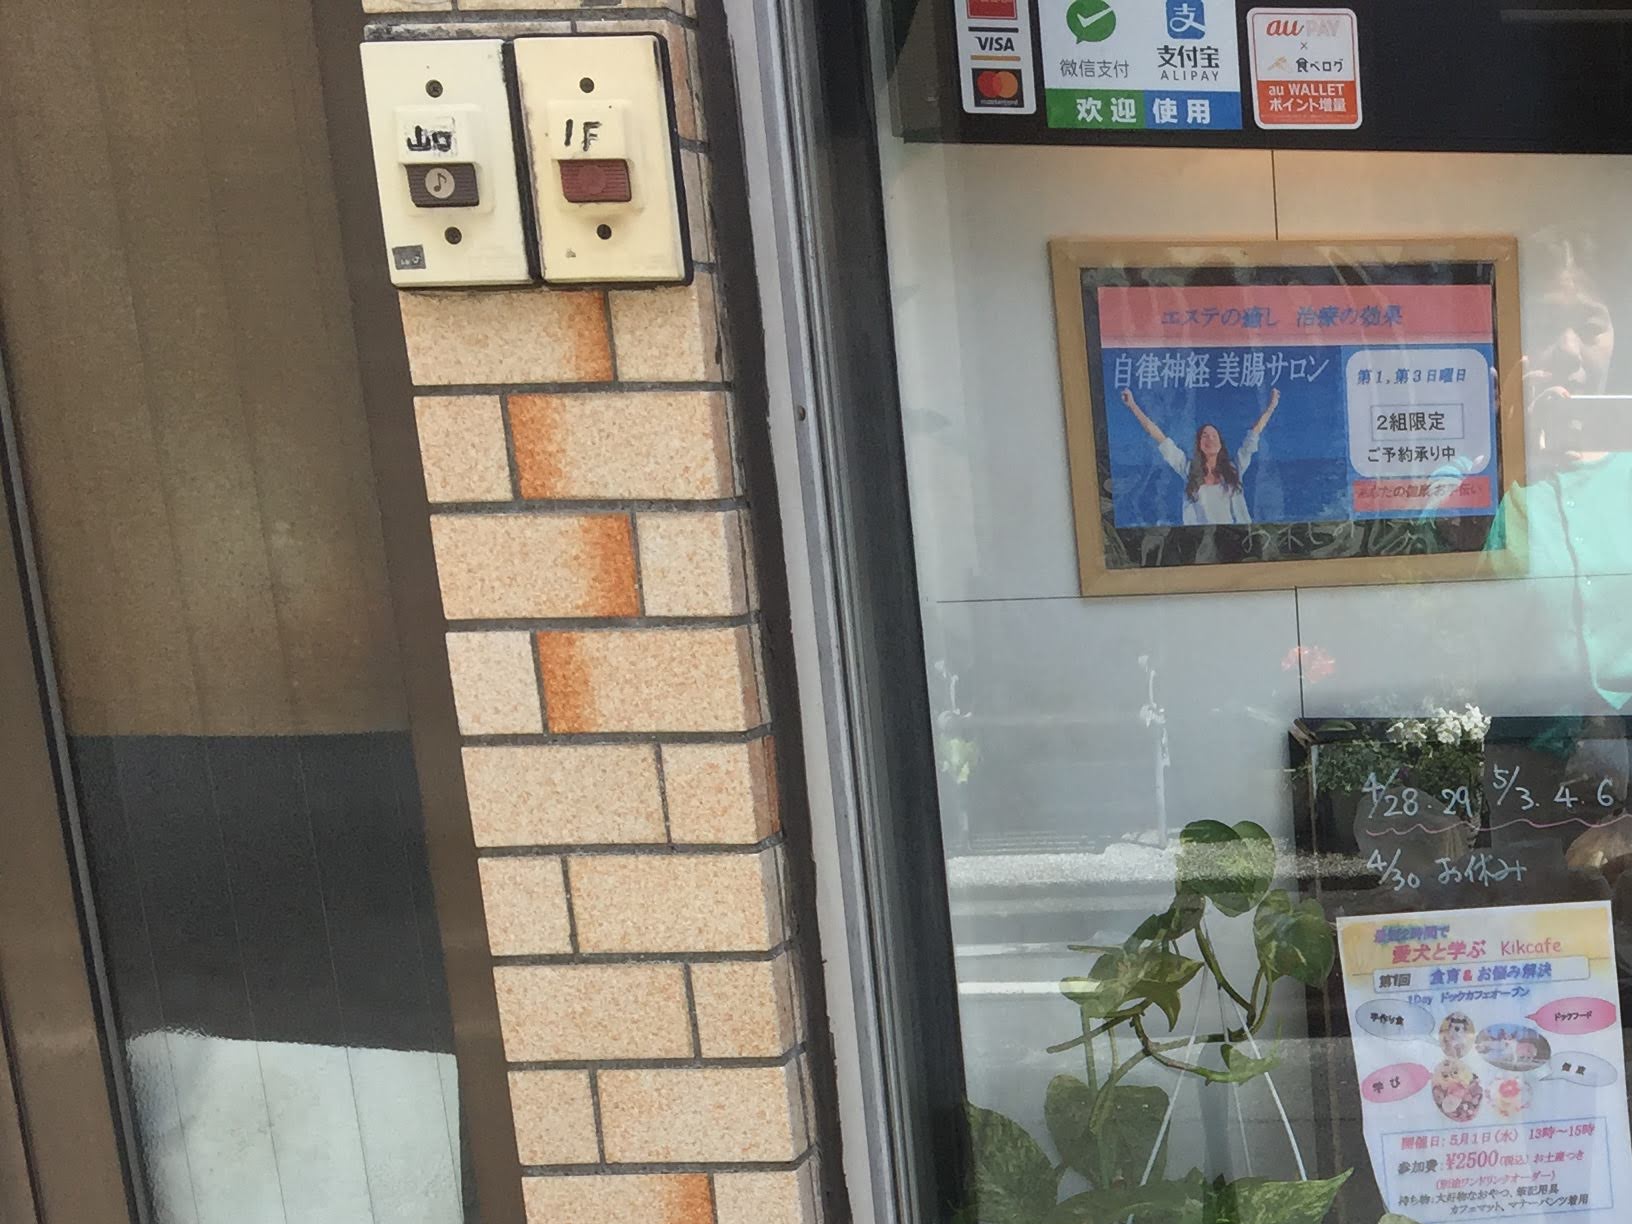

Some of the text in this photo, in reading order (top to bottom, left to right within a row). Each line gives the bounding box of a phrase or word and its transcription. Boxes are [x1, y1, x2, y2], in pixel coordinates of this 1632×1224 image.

[1266, 19, 1304, 36] au
[975, 36, 1015, 51] VISA
[1157, 45, 1219, 69] 支付宝
[1296, 57, 1343, 72] 食べログ
[1060, 58, 1129, 78] 微信支付
[1160, 71, 1219, 81] ALIPAY
[1268, 84, 1345, 95] au WALLET
[1270, 98, 1347, 112] ポイント増量
[1114, 352, 1330, 388] 自律神経 美腸サロン
[1376, 412, 1445, 432] 2組限定
[1368, 446, 1456, 463] ご予約承り中
[1434, 853, 1527, 886] お休み
[1392, 940, 1486, 964] 愛犬と学ぶ
